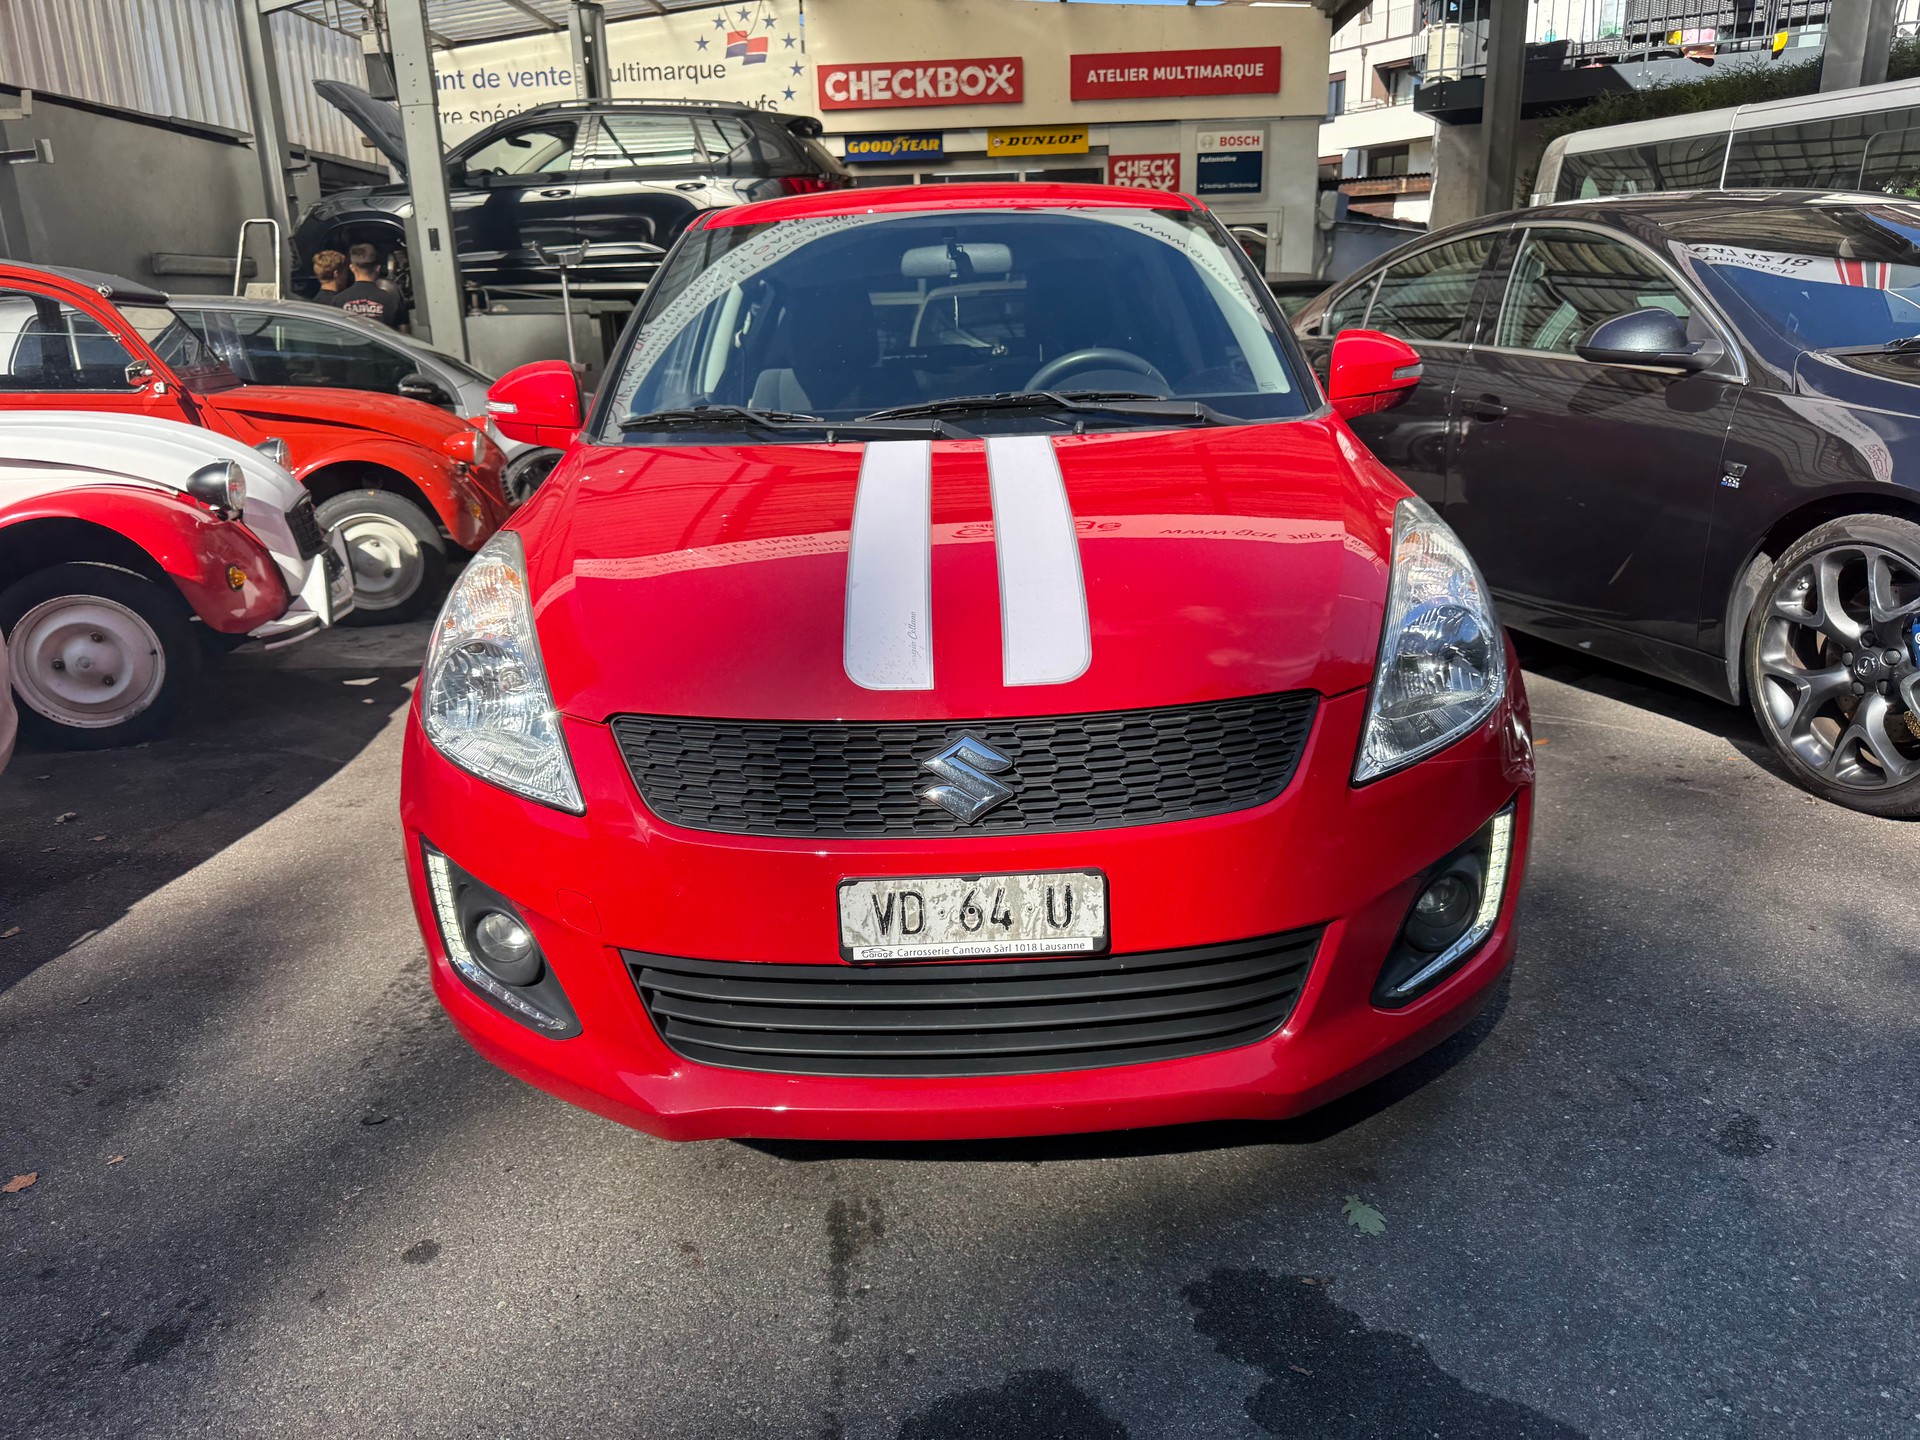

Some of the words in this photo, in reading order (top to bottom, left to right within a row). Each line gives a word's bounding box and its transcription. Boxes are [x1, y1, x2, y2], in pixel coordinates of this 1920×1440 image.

[435, 70, 466, 90] int
[472, 68, 500, 89] de
[508, 67, 572, 87] vente
[608, 62, 726, 85] ultimarque
[825, 64, 1015, 101] CHECKBOX
[1087, 67, 1149, 84] ATELIER
[1153, 63, 1264, 82] MULTIMARQUE
[1007, 134, 1083, 147] DUNLOP
[1219, 136, 1260, 147] BOSCH
[1114, 159, 1175, 178] CHECK
[907, 611, 918, 639] Cellano
[872, 890, 924, 935] VD
[960, 887, 1013, 932] 64
[1046, 884, 1073, 929] U
[897, 947, 950, 957] Carrosserie
[952, 945, 991, 955] Cantova
[1015, 943, 1037, 952] 1018
[1040, 942, 1085, 951] Lausanne
